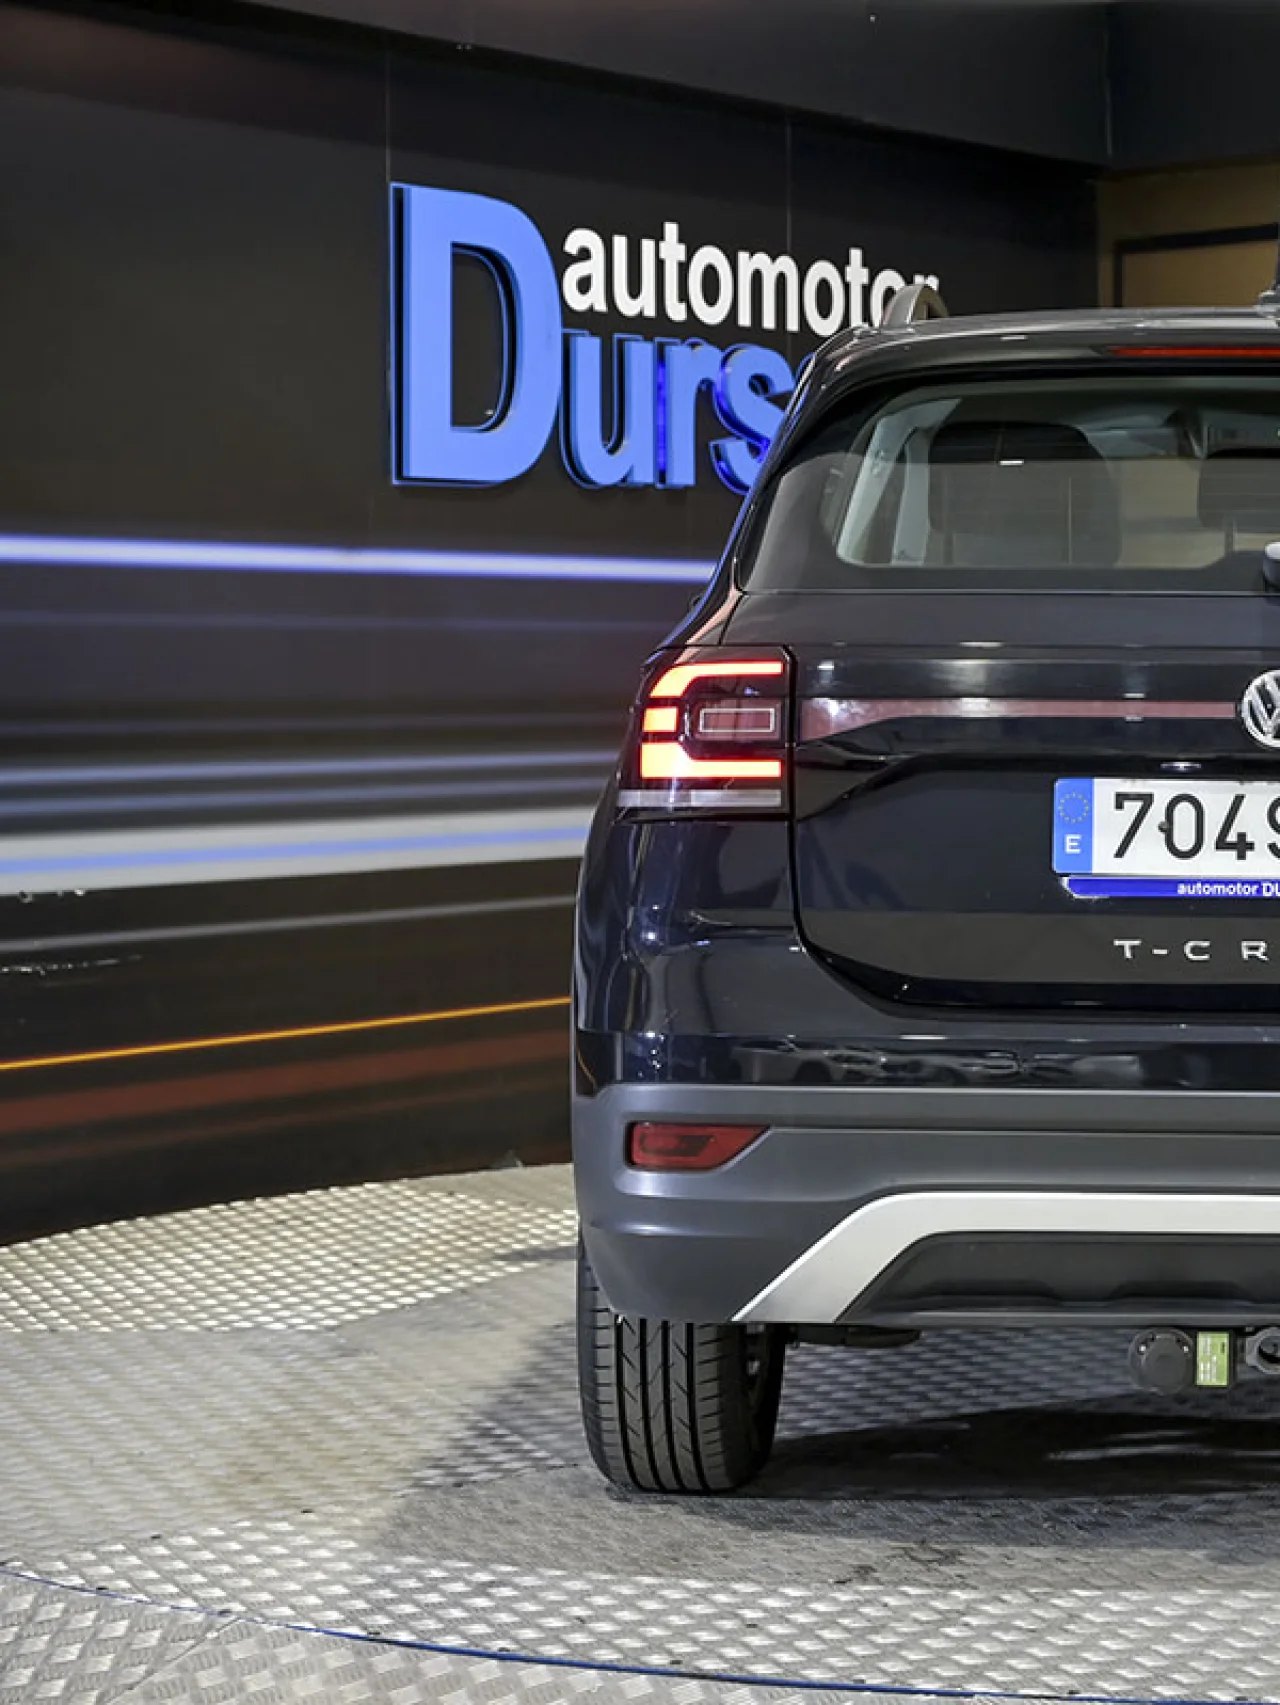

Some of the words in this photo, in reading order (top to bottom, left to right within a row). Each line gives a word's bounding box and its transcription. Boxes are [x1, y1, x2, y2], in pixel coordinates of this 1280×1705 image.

[390, 182, 815, 496] Durs
[1064, 834, 1082, 854] E
[1177, 882, 1259, 896] automotor
